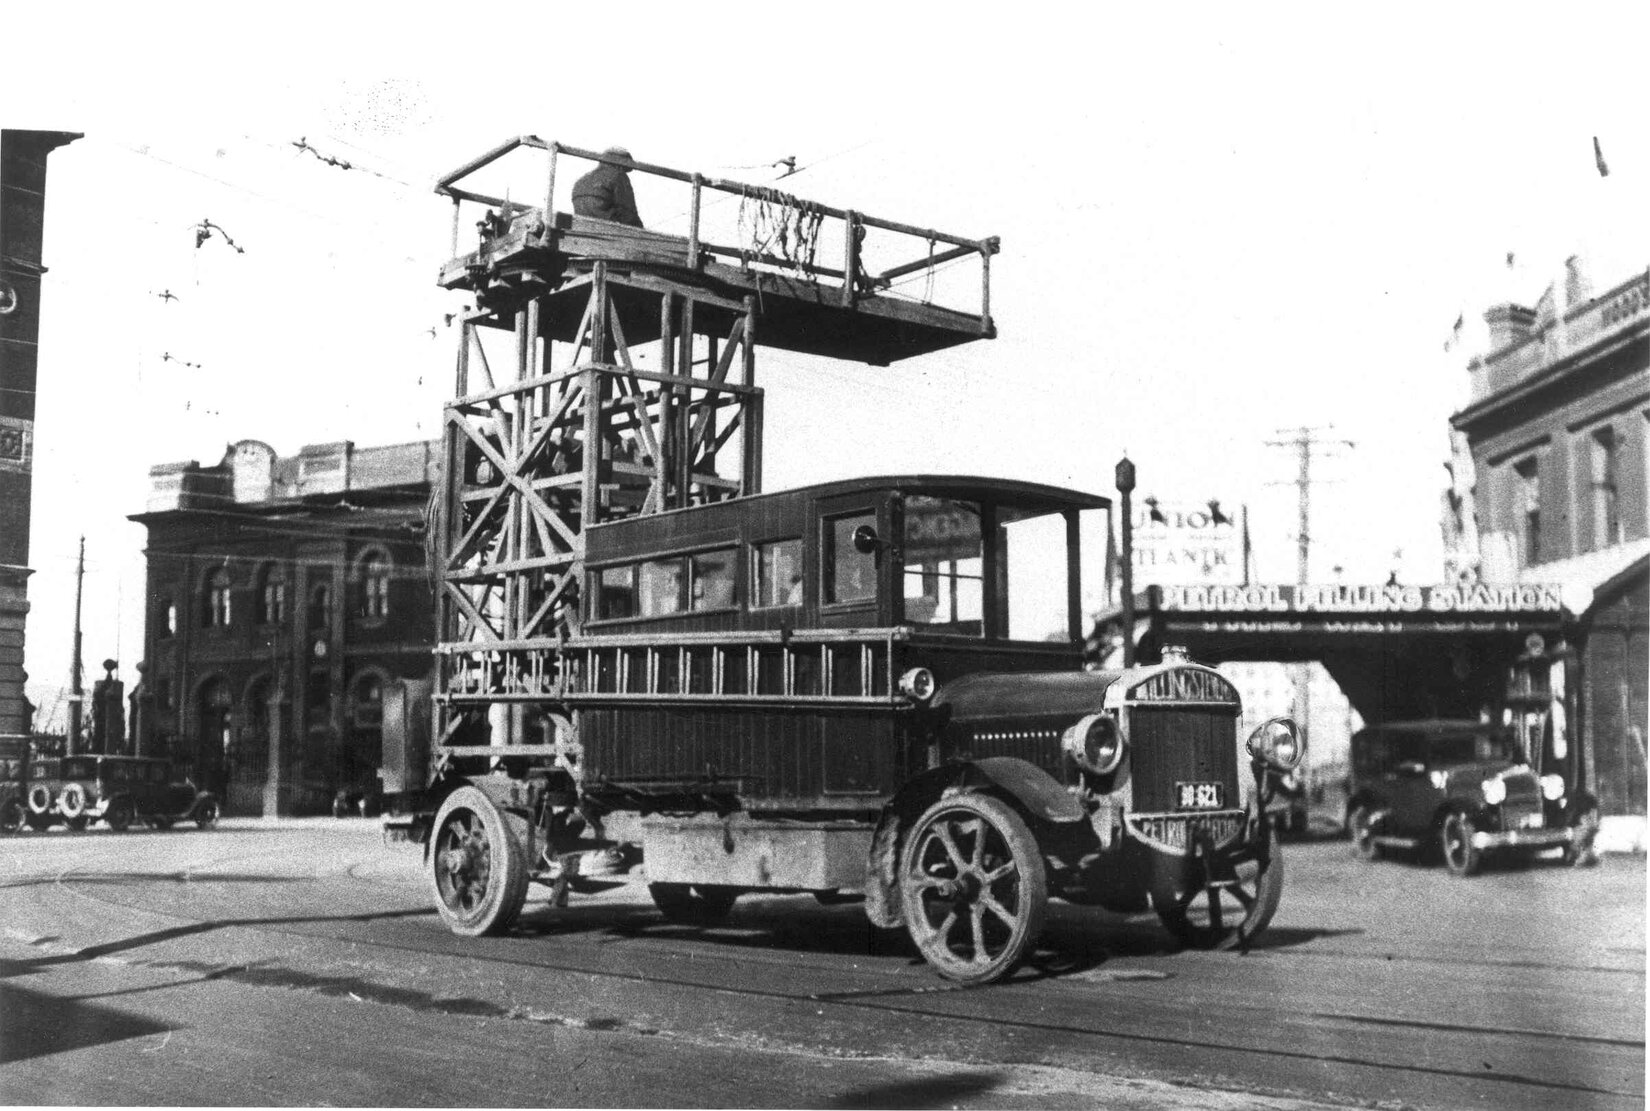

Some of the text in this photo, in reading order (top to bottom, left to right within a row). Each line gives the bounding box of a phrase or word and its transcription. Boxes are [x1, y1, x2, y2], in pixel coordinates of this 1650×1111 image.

[1161, 584, 1560, 612] PETROL FILLING STATION
